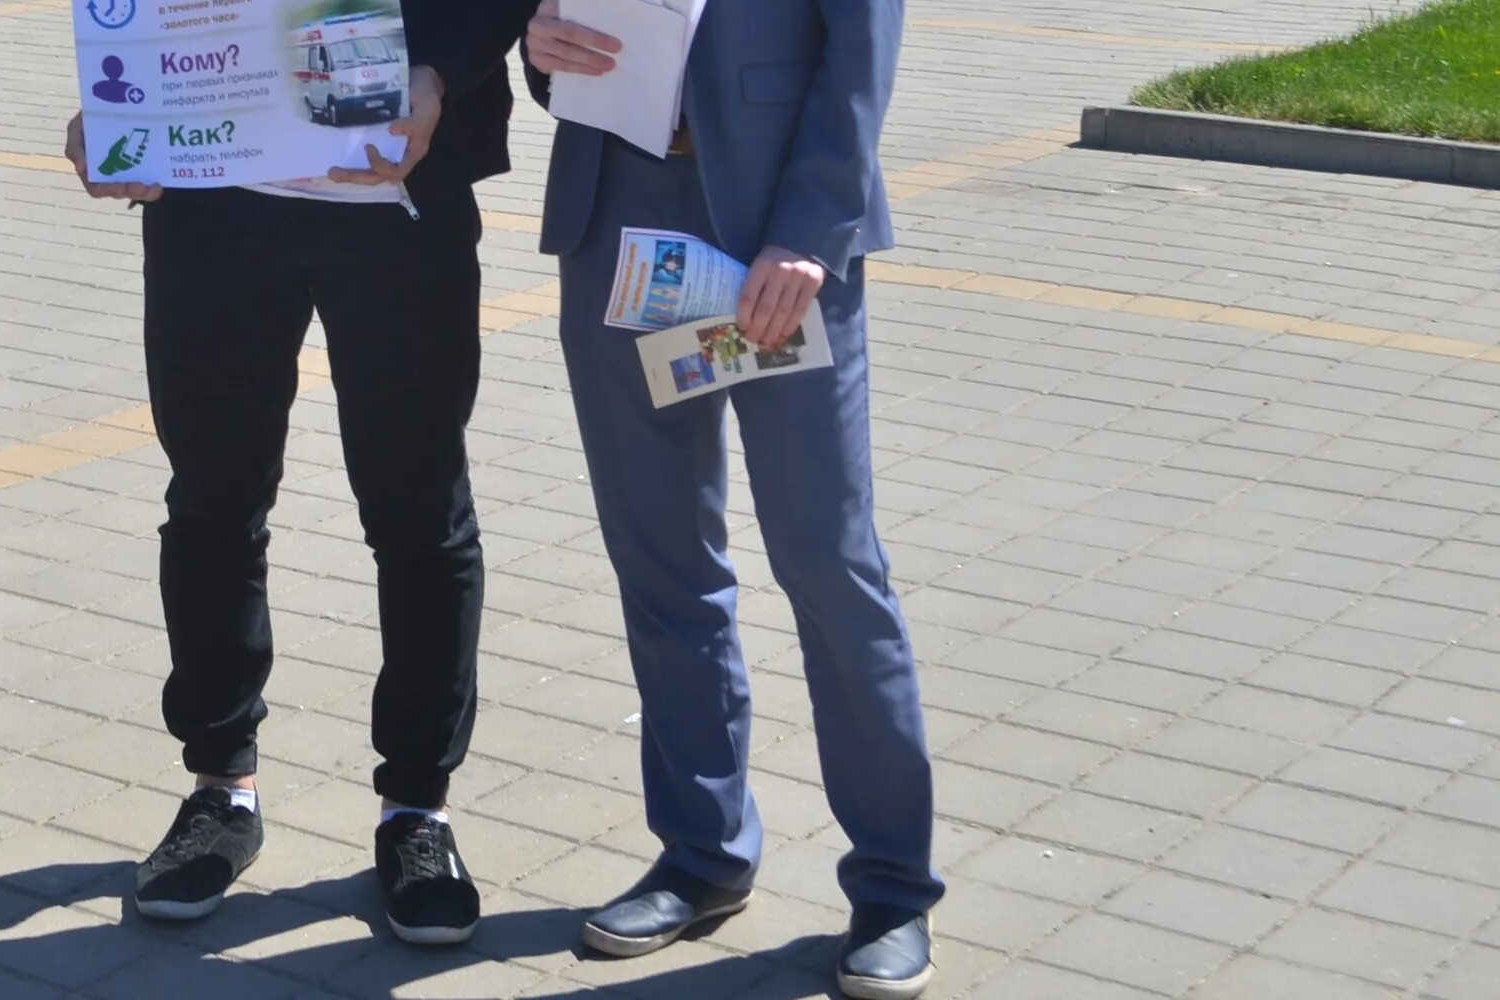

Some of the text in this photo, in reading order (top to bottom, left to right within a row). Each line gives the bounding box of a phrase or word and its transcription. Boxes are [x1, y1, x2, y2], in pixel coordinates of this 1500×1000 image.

[160, 44, 240, 75] Кому?
[162, 70, 279, 92] при первых признаках
[163, 94, 216, 106] инфаркта
[228, 87, 270, 100] инсульта
[168, 120, 235, 147] Как?
[170, 148, 263, 164] набрать телефон
[172, 166, 225, 179] 103, 112
